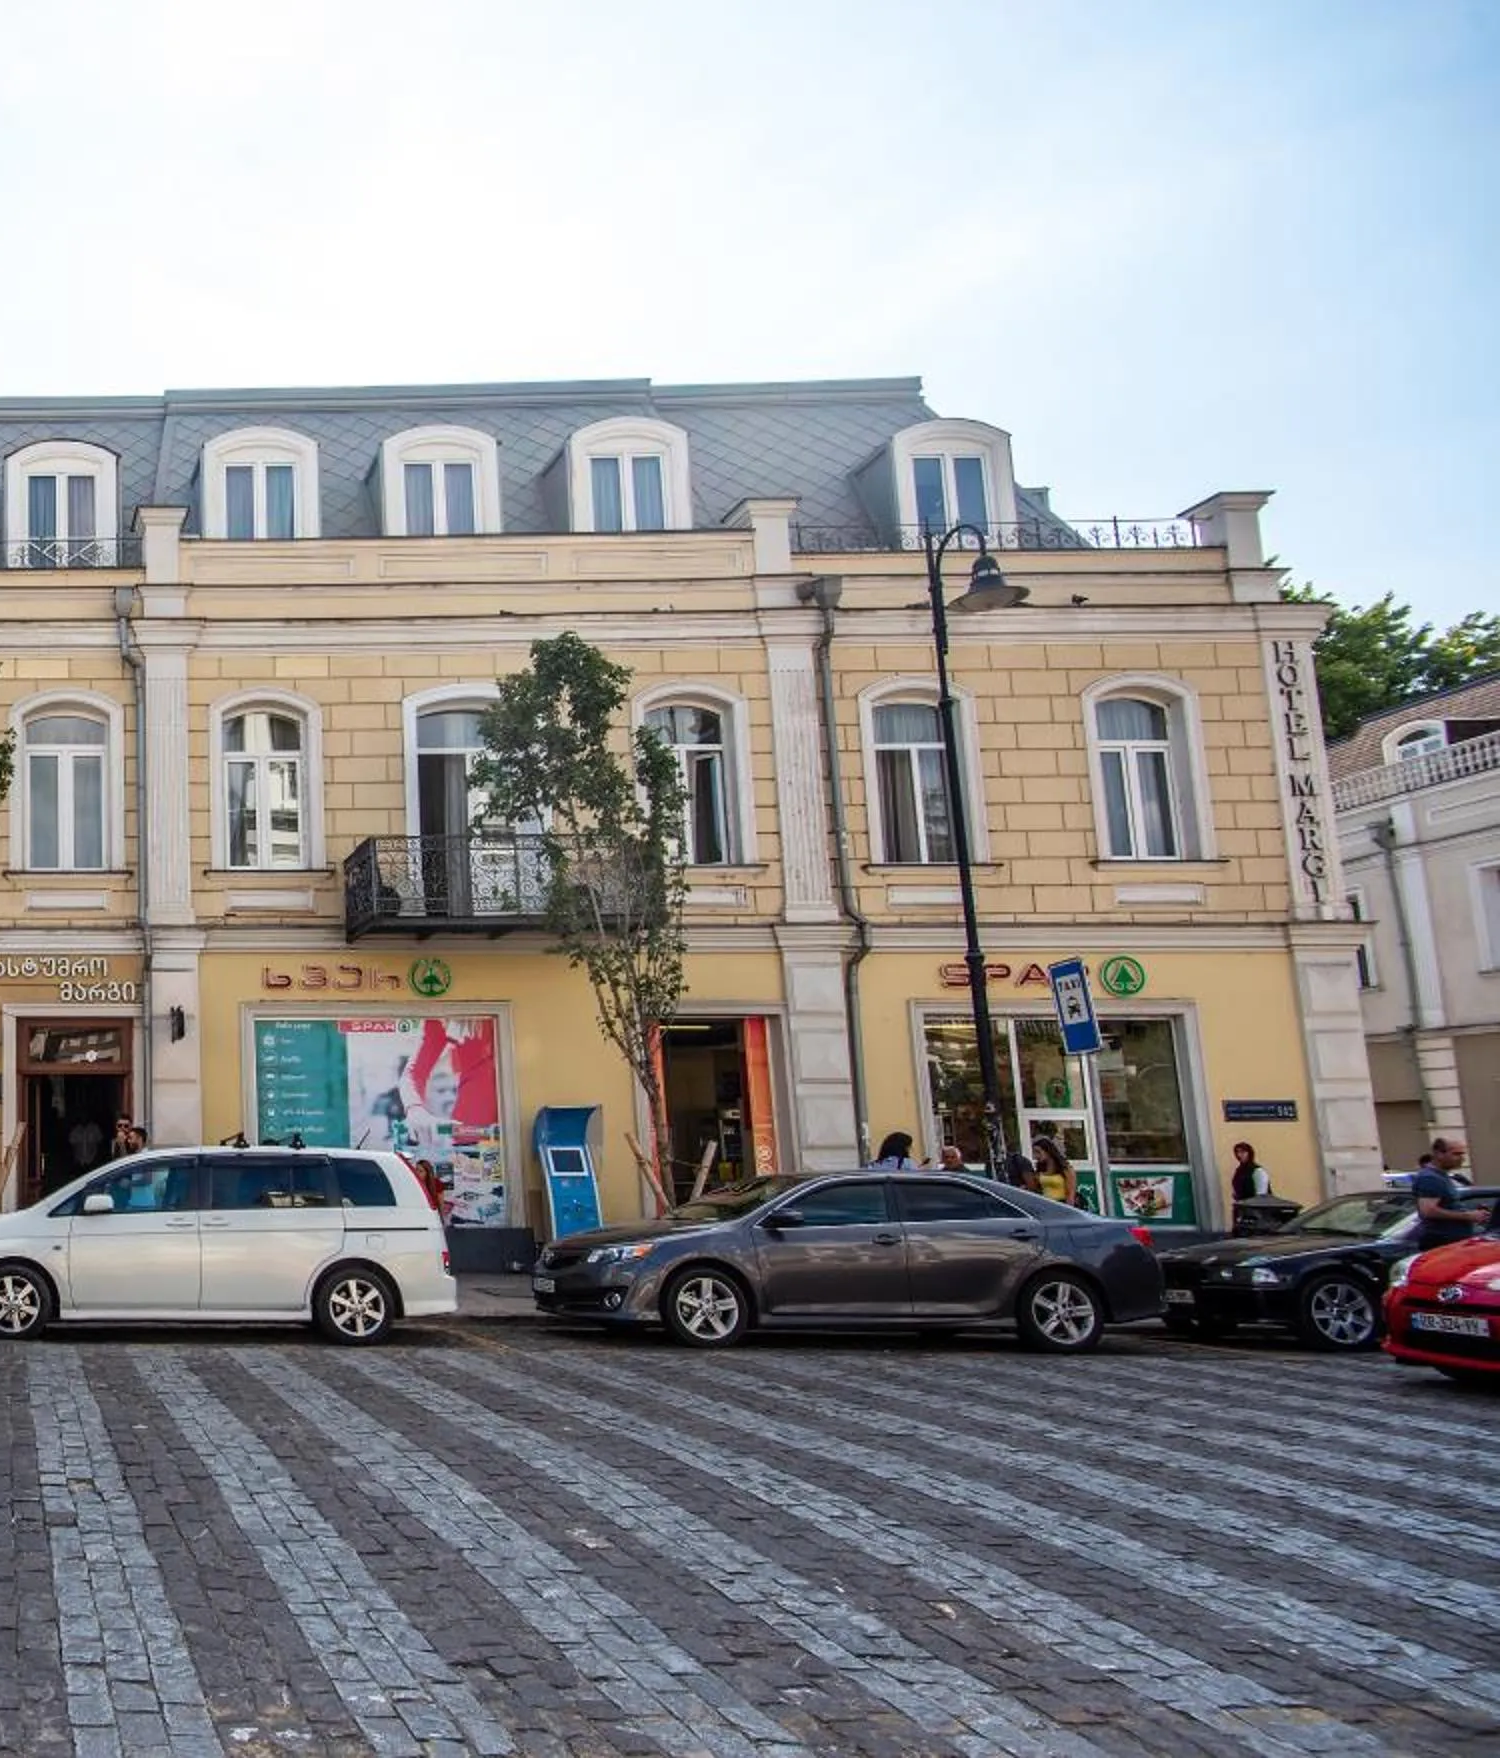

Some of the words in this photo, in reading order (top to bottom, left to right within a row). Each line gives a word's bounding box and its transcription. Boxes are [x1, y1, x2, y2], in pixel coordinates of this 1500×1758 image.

[1272, 640, 1311, 761] HOTEL
[1289, 774, 1326, 903] MARGI
[60, 981, 135, 1001] მარგი
[939, 963, 1090, 988] SPA
